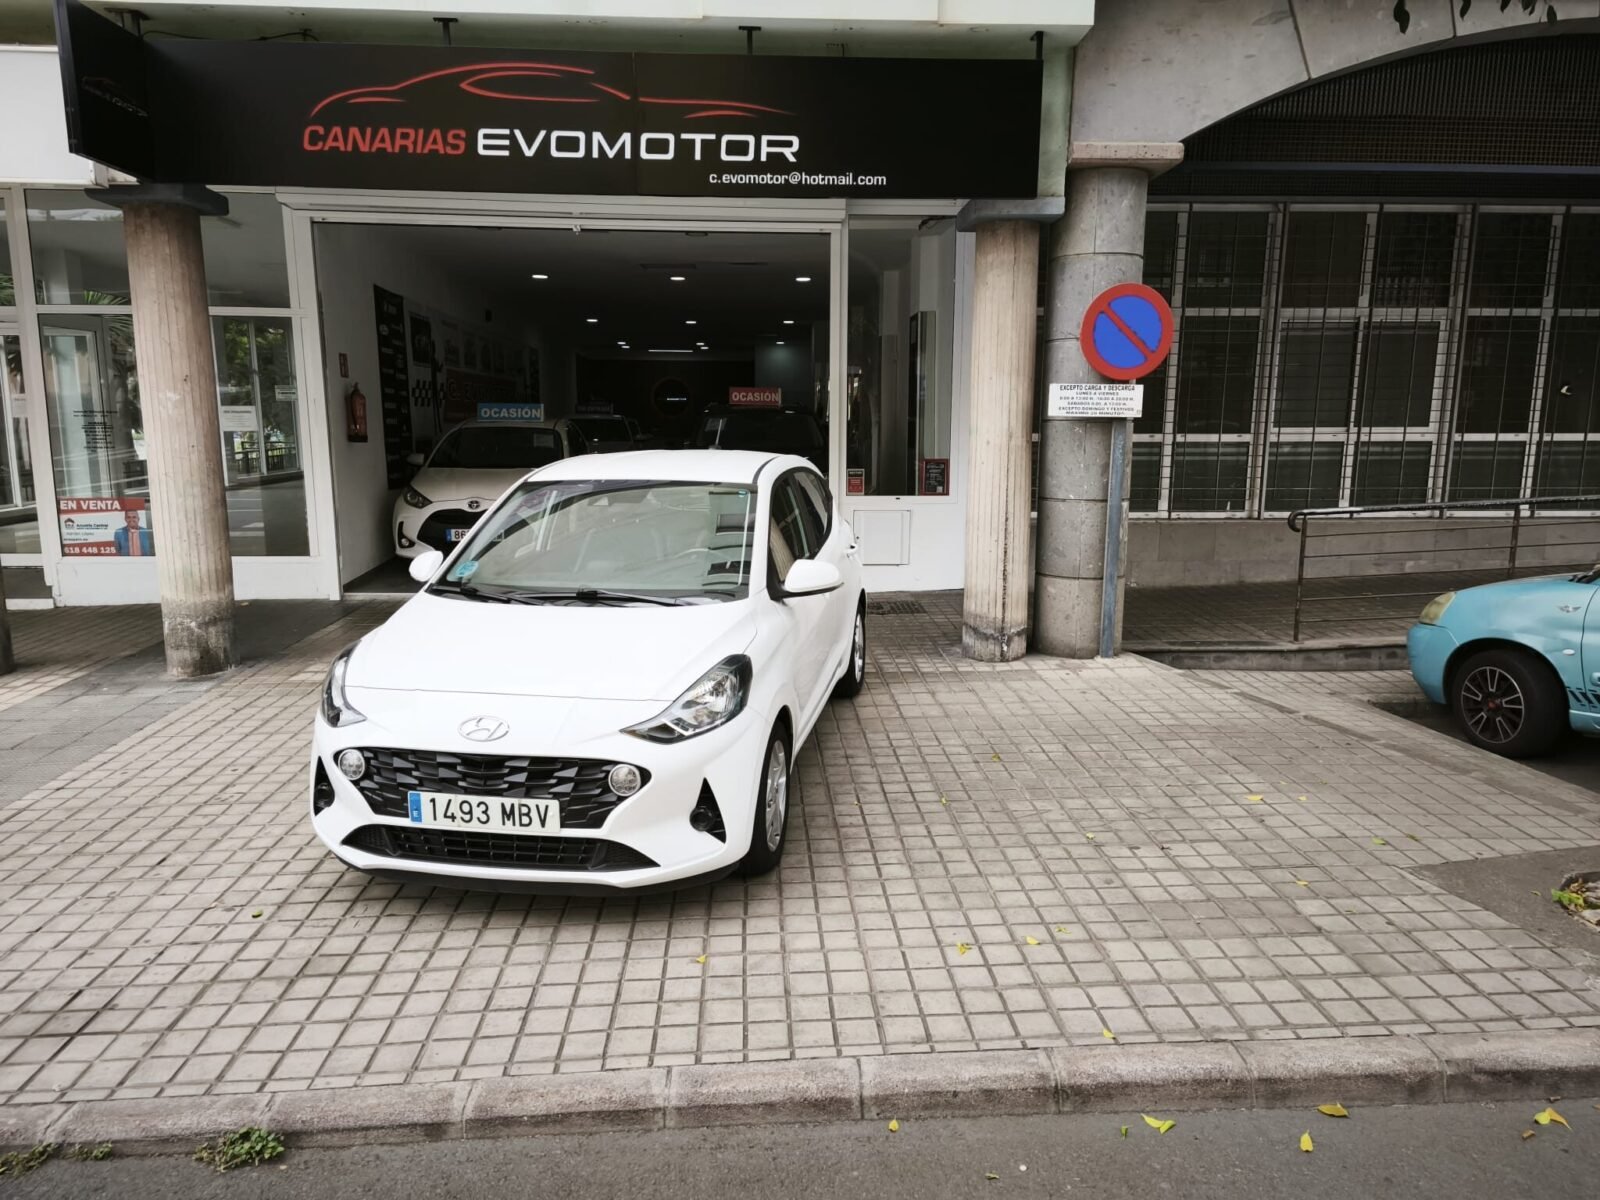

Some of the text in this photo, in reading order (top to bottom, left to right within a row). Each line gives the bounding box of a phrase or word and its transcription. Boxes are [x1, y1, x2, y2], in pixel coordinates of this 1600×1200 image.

[303, 125, 800, 163] CANARIAS EVOMOTOR
[709, 171, 887, 186] c.evomotor@hotmail.com
[731, 390, 779, 402] OCASIÓN
[481, 406, 542, 418] OCASIÓN
[60, 500, 121, 510] EN VENTA
[64, 546, 116, 554] 618 448 125
[429, 797, 549, 828] 1493 MBV
